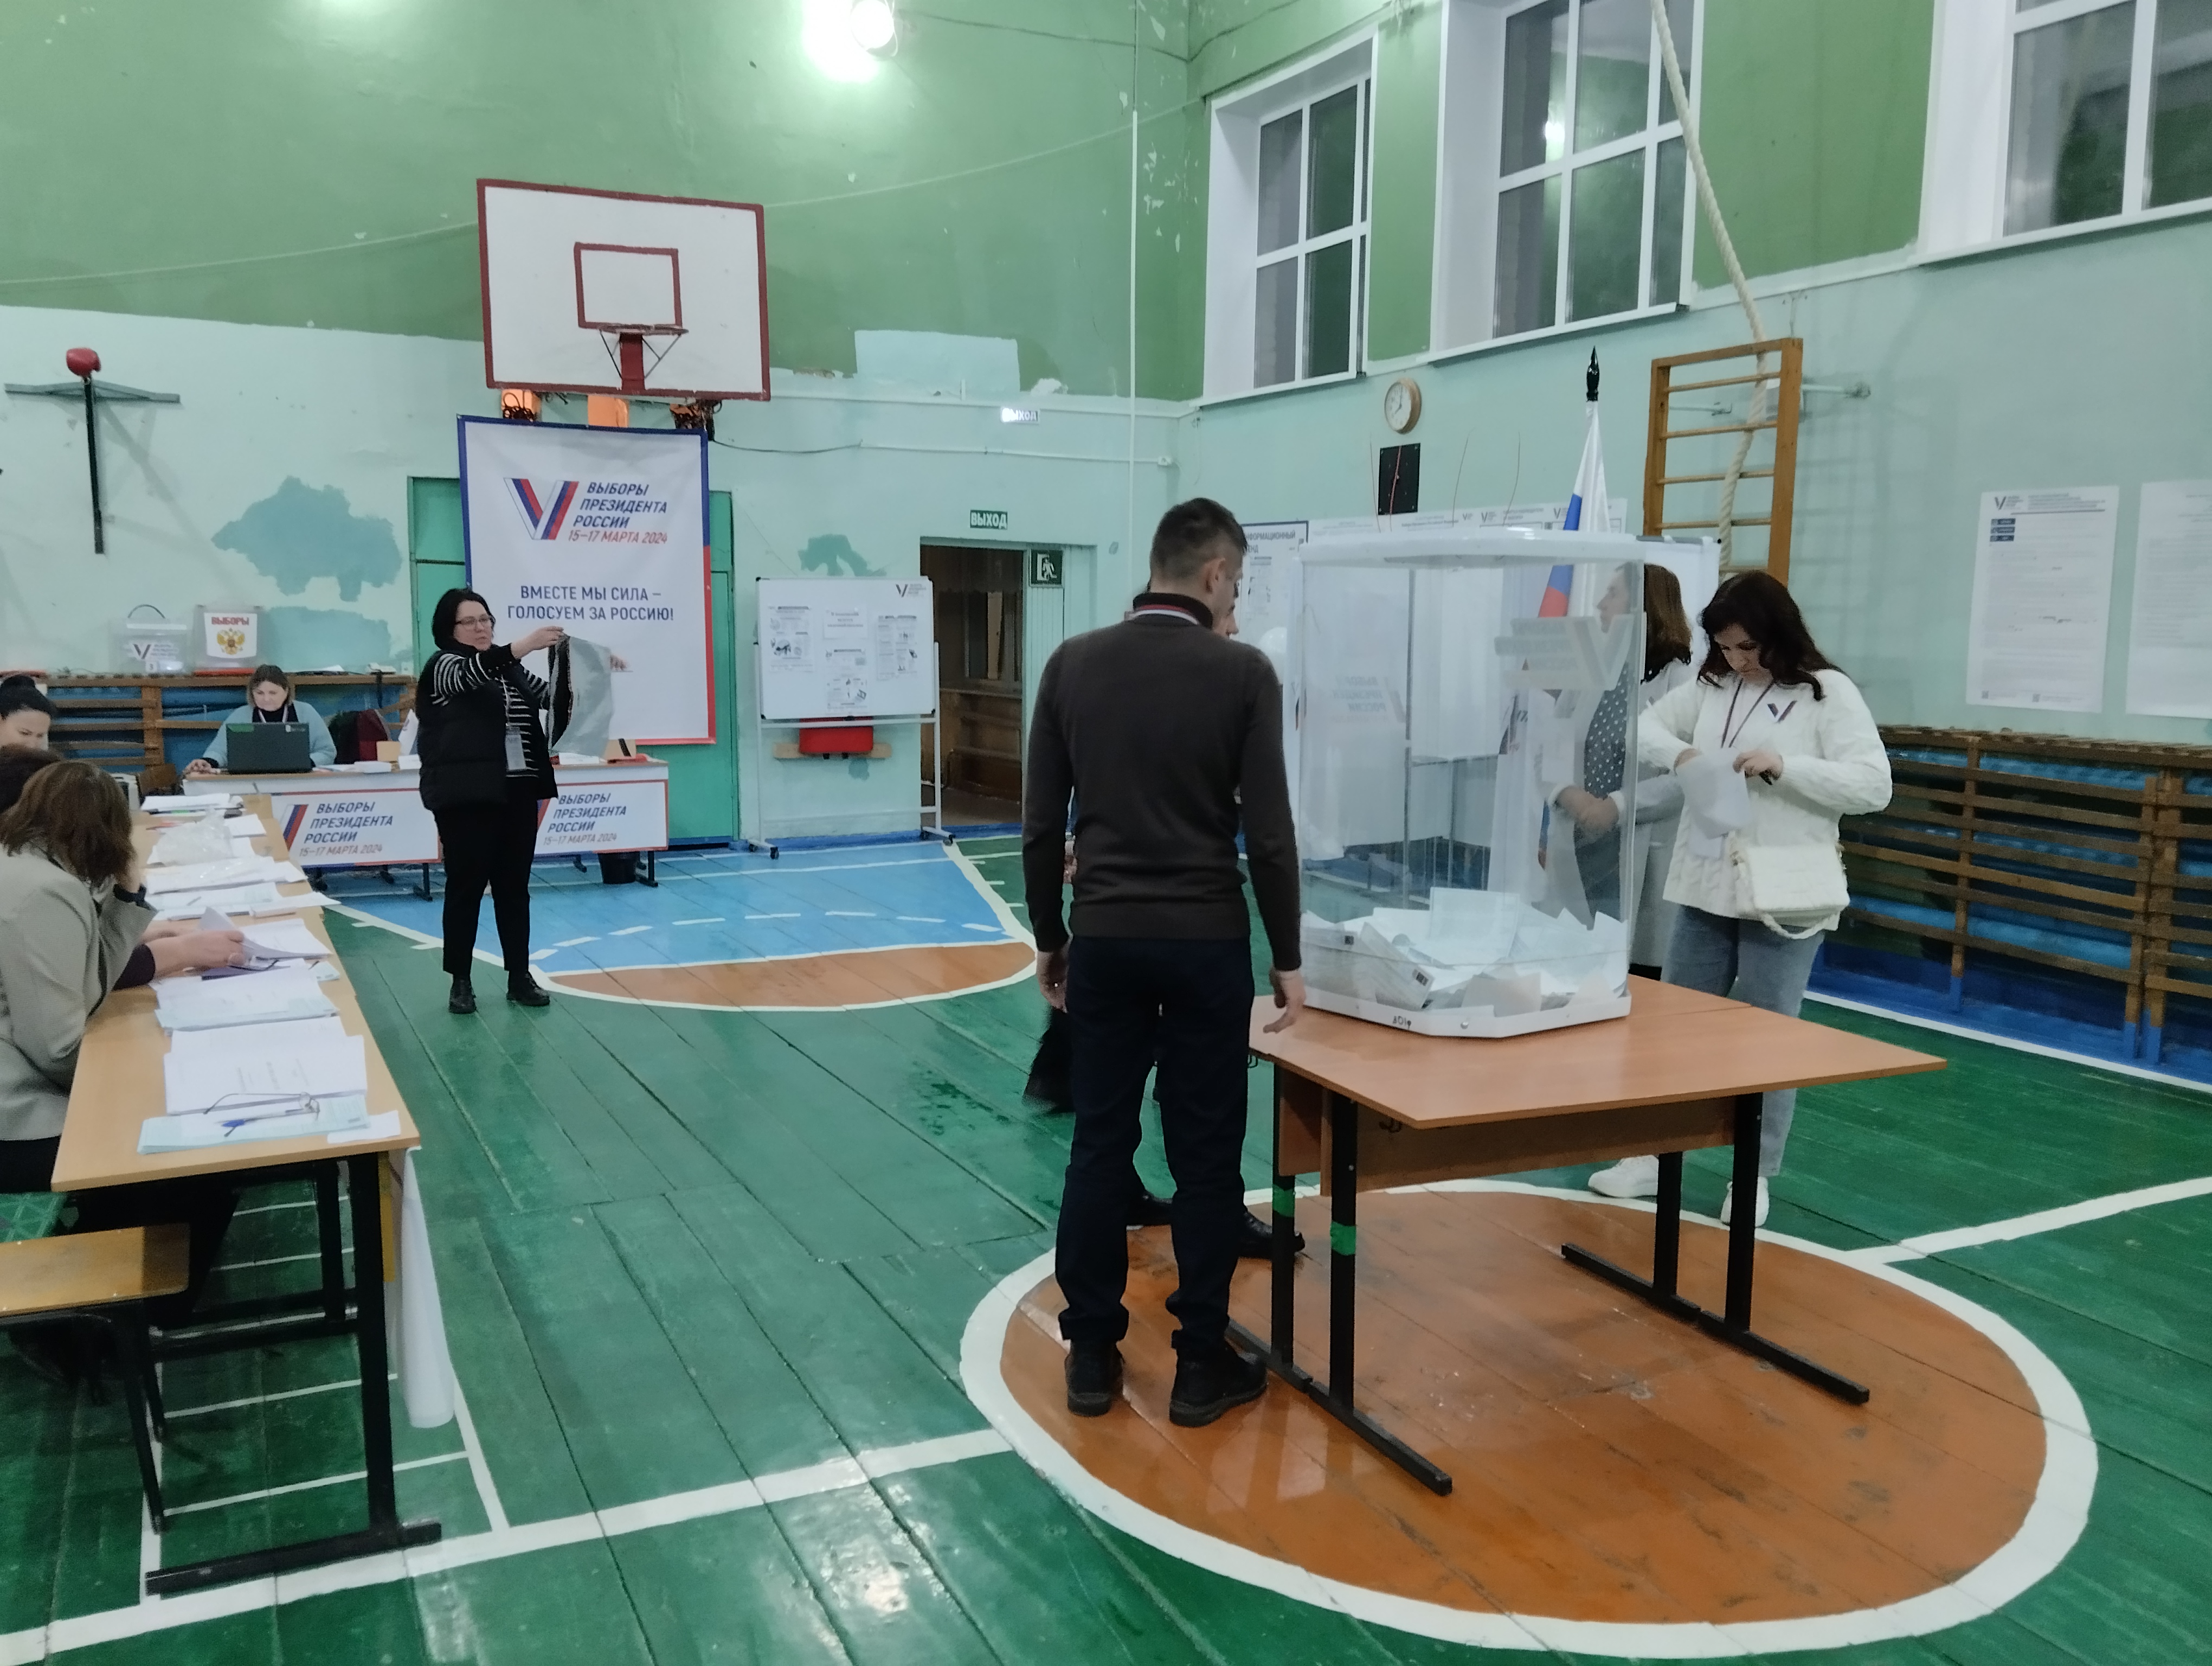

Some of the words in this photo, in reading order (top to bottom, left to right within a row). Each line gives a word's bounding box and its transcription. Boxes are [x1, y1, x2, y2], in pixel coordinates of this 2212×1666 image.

[1002, 408, 1037, 422] ЫХОД
[587, 482, 649, 496] ВЫБОРЫ
[580, 498, 667, 514] ПРЕЗИДЕНТА
[573, 515, 630, 529] РОССИИ
[970, 512, 1007, 530] ВЫХОД
[601, 530, 639, 543] МАРТА
[641, 532, 667, 544] 2024
[1246, 529, 1295, 541] НФОРМАЦИОННЫЙ
[1247, 544, 1259, 553] ЕНД
[520, 586, 577, 600] ВМЕСТЕ
[582, 586, 606, 600] МЫ
[611, 587, 648, 601] СИЛА
[507, 605, 584, 620] ГОЛОСУЕМ
[589, 606, 606, 620] ЗА
[610, 607, 674, 620] РОССИЮ!
[211, 617, 249, 625] ВЫБОРЫ
[558, 793, 611, 805] ВЫБОРЫ
[317, 802, 375, 814] ВЫБОРЫ
[553, 806, 627, 819] ПРЕЗИДЕНТА
[310, 816, 393, 829] ПРЕЗИДЕНТА
[548, 821, 596, 833] РОССИИ
[304, 831, 358, 844] РОССИИ
[568, 834, 596, 844] МАРТА
[597, 833, 617, 843] 2024
[326, 845, 358, 856] МАРТА
[360, 844, 383, 854] 2024
